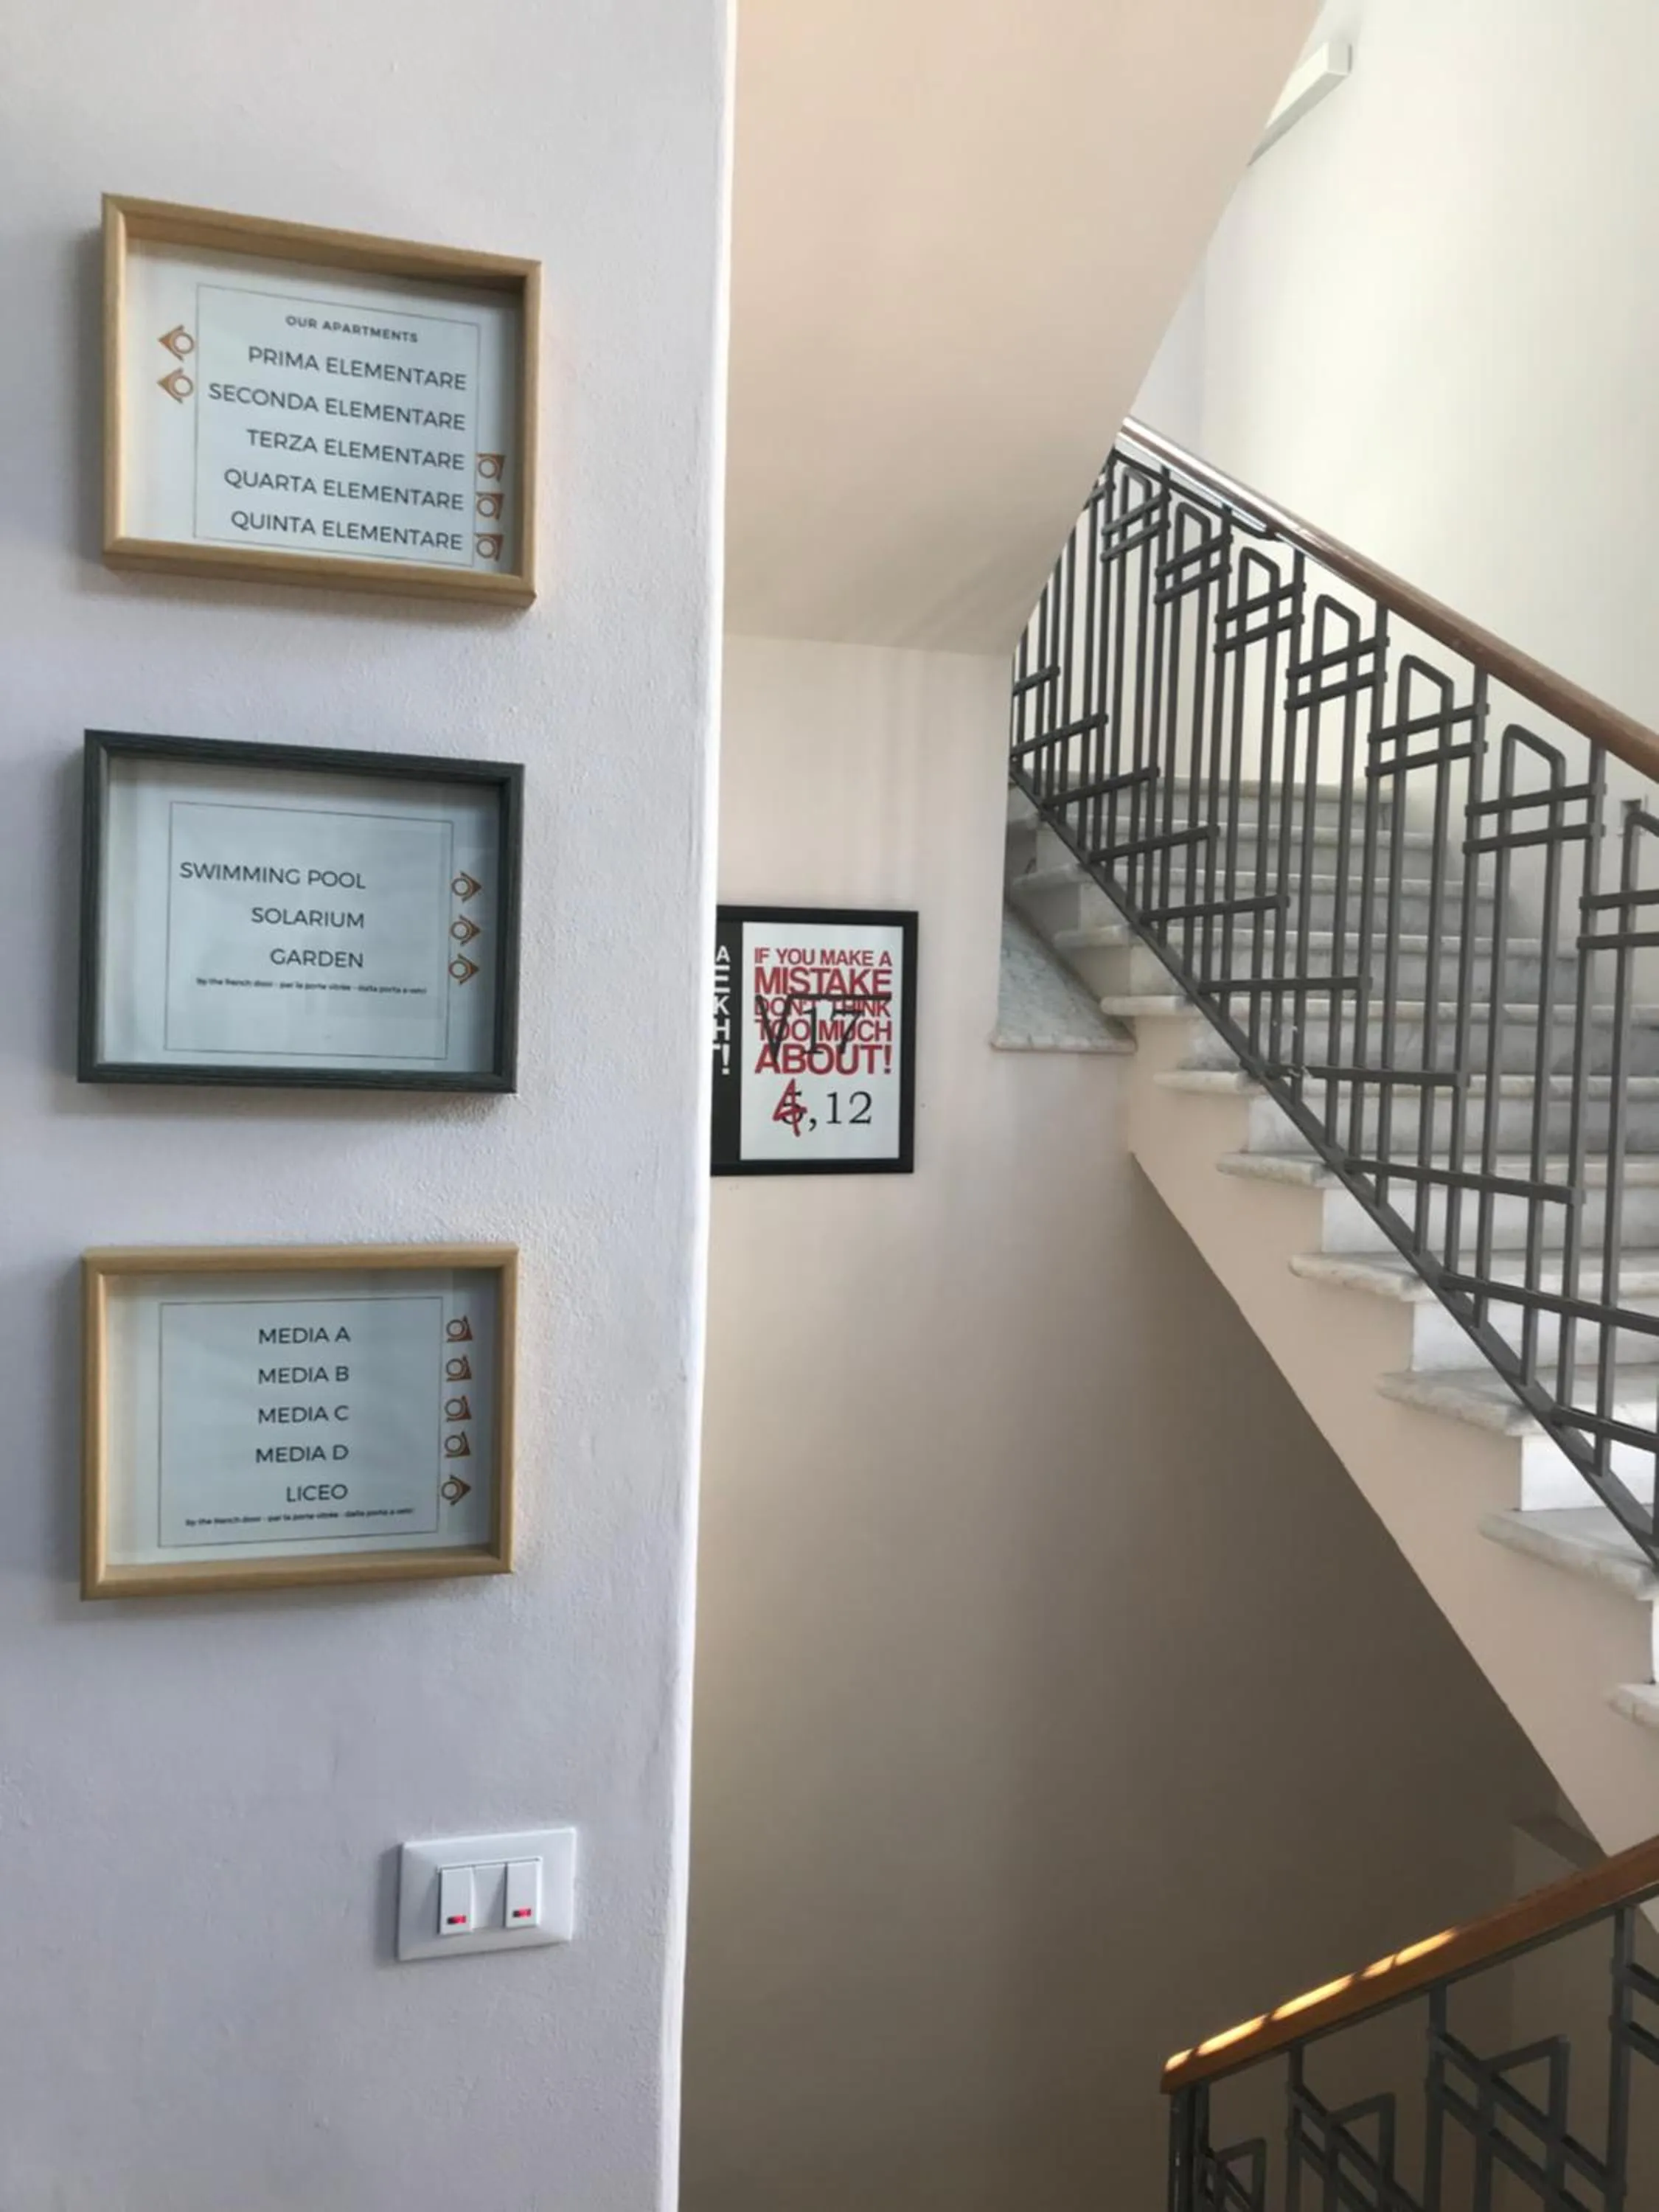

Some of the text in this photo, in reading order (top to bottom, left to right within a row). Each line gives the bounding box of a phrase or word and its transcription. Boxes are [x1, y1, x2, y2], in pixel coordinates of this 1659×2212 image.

[285, 315, 419, 344] OUR APARTMENTS
[248, 345, 467, 391] PRIMA ELEMENTARE
[208, 383, 466, 431] SECONDA ELEMENTARE
[246, 428, 465, 470] TERZA ELEMENTARE
[223, 468, 465, 511] QUARTA ELEMENTARE
[231, 509, 463, 551] QUINTA ELEMENTARE
[179, 862, 366, 890] SWIMMING POOL
[251, 907, 365, 929] SOLARIUM
[270, 948, 364, 969] GARDEN
[754, 947, 892, 967] IF YOU MAKE A
[754, 967, 892, 995] MISTAKE
[754, 996, 818, 1016] DON'T
[754, 1018, 810, 1042] TOO
[818, 1019, 892, 1042] MUCH
[754, 1043, 891, 1075] ABOUT!
[258, 1326, 351, 1345] MEDIA A
[258, 1366, 349, 1385] MEDIA B
[257, 1405, 349, 1424] MEDIA C
[255, 1444, 349, 1464] MEDIA D
[286, 1484, 348, 1503] LICEO
[198, 1517, 213, 1526] the
